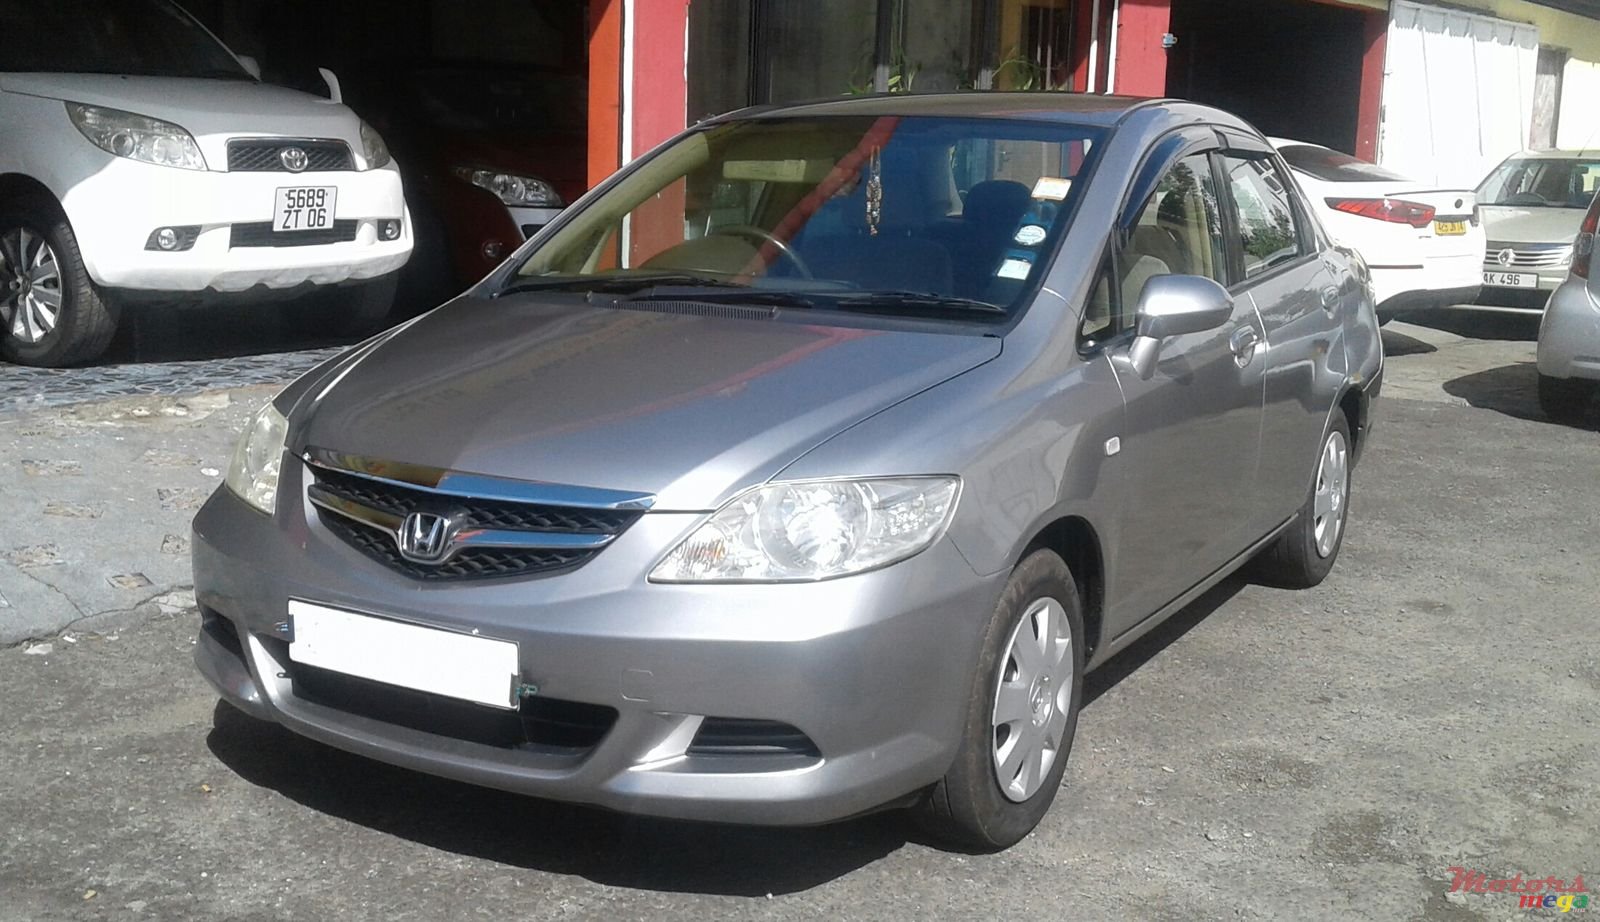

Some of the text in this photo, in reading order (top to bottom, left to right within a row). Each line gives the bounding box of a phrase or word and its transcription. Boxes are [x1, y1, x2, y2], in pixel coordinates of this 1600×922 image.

[287, 189, 325, 208] 5689
[282, 208, 326, 229] ZT 06
[1500, 274, 1521, 285] 496
